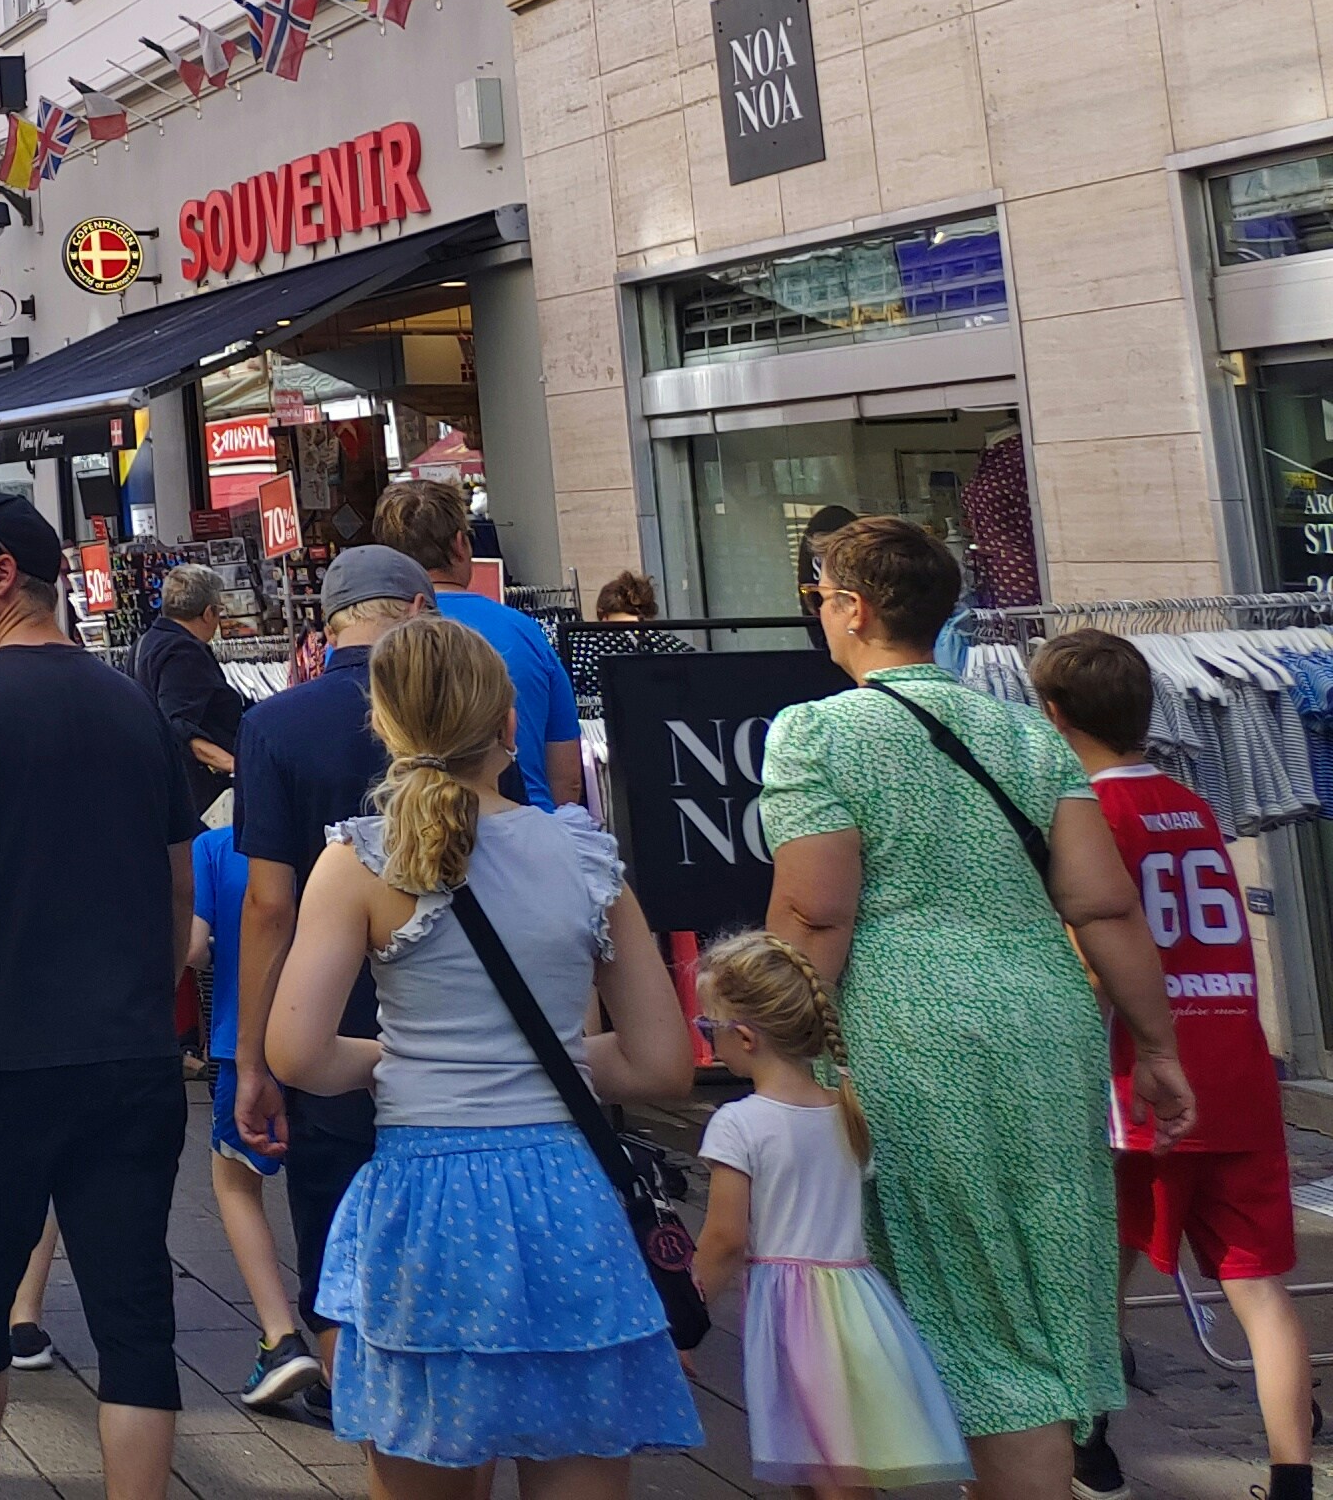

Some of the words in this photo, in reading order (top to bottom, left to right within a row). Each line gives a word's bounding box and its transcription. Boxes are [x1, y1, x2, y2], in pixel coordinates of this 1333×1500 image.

[729, 20, 797, 85] NOA
[735, 73, 804, 137] NOA
[72, 220, 136, 246] COPENHAGEN
[179, 121, 431, 282] SOUVENIR
[264, 506, 295, 548] 70%
[86, 569, 112, 604] 50%
[1140, 850, 1243, 949] 66
